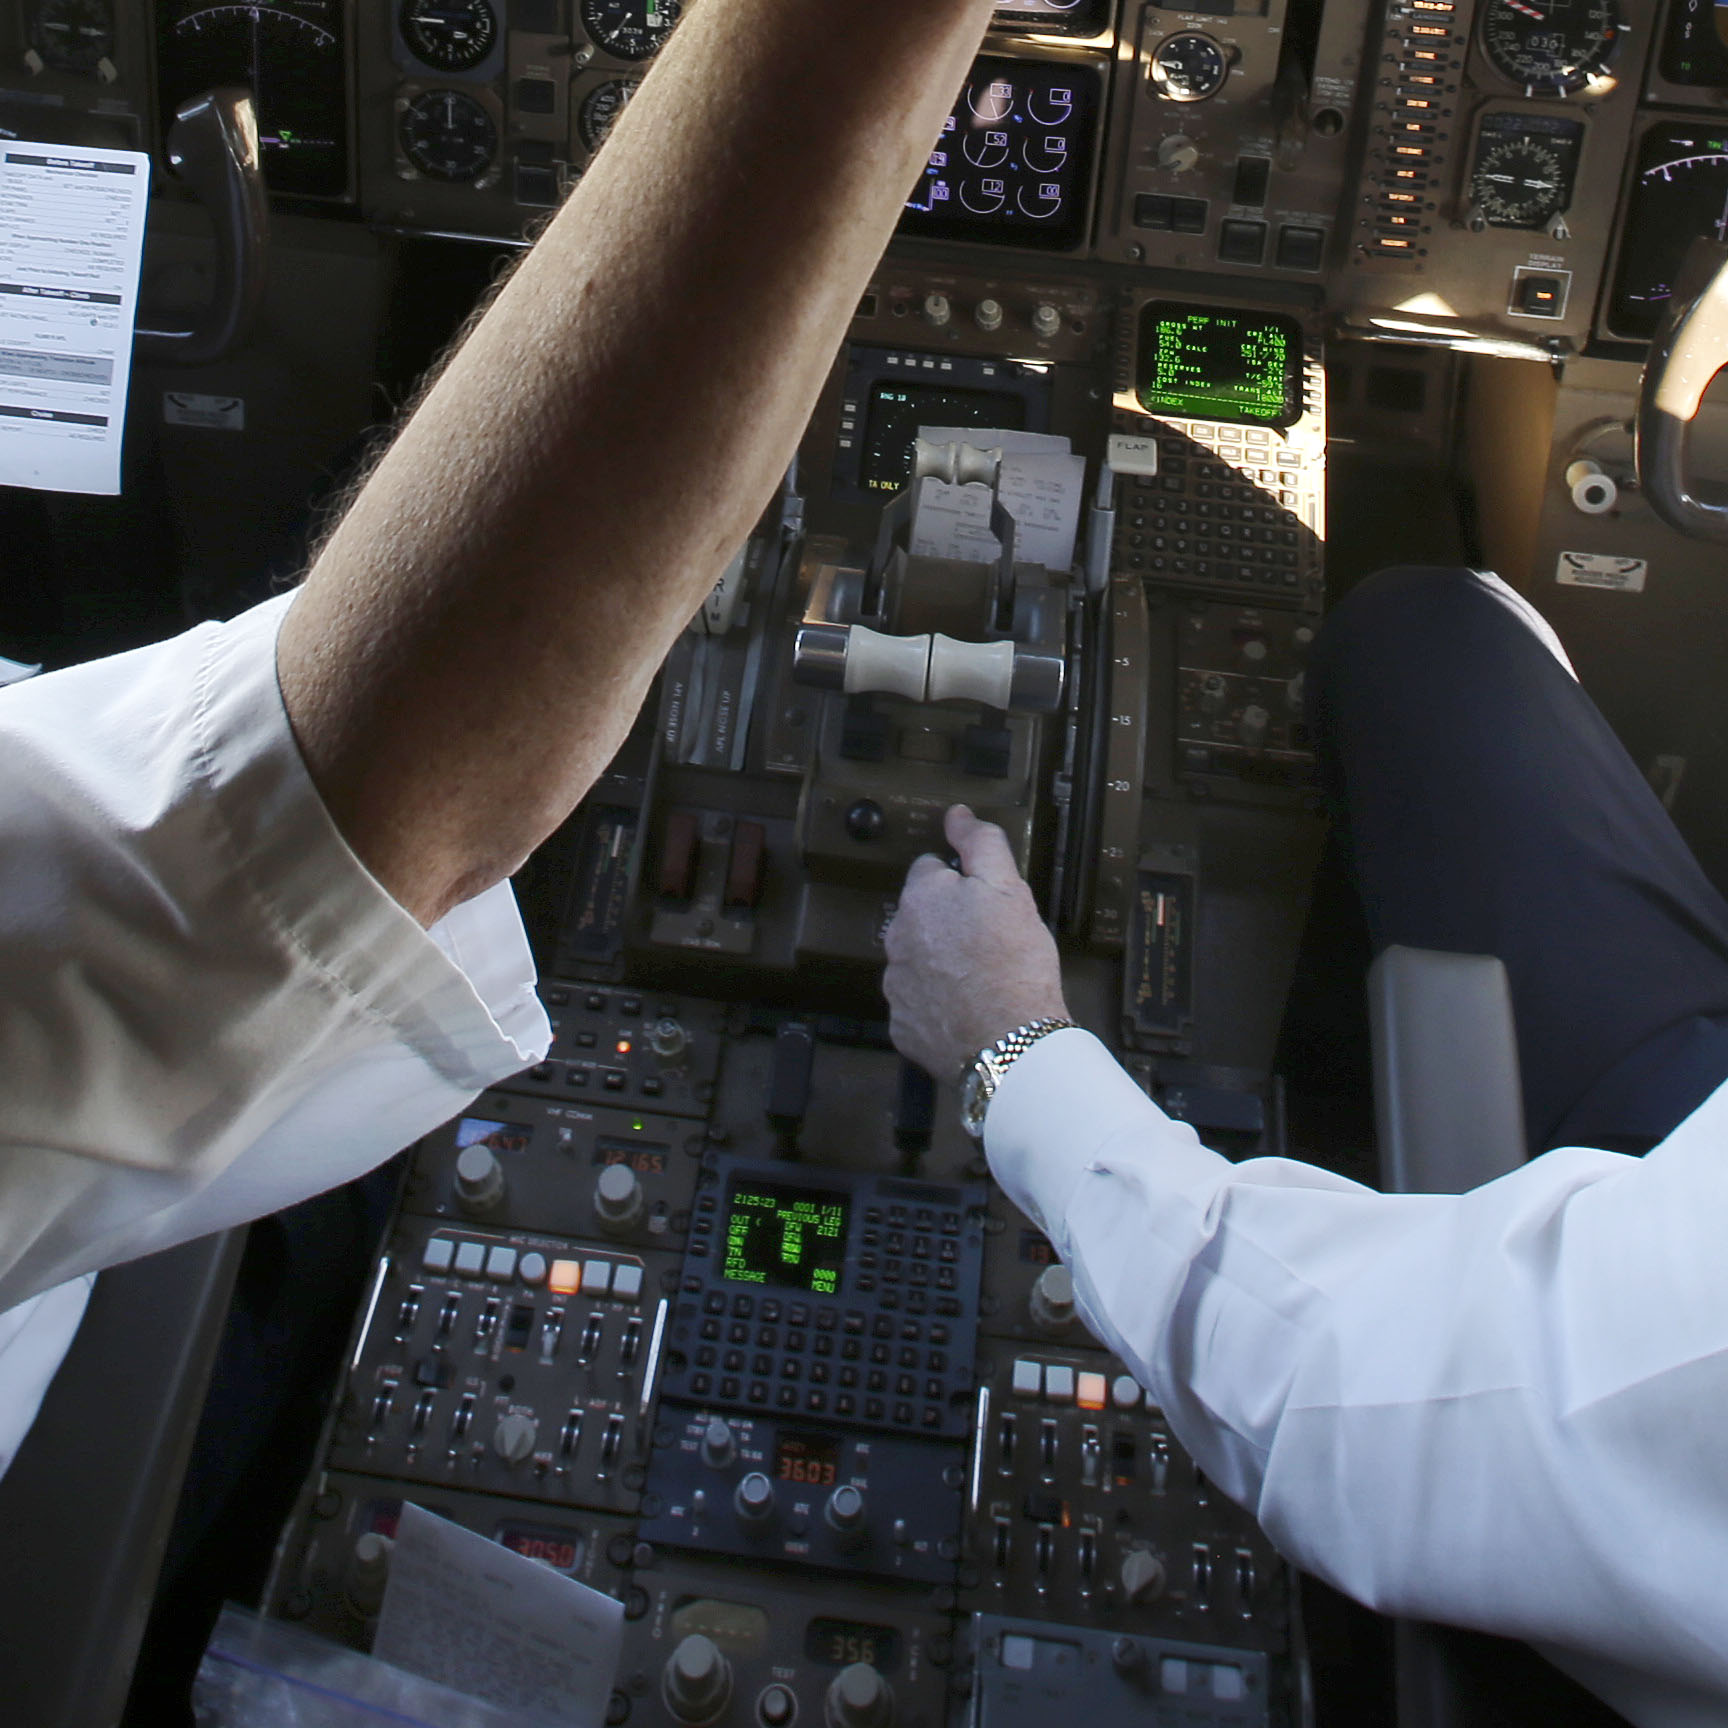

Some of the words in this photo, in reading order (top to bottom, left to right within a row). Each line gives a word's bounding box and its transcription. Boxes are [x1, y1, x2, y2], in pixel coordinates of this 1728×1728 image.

[1185, 380, 1211, 388] INDEX
[1117, 441, 1149, 451] FLAP
[881, 480, 899, 490] ONLY
[1122, 657, 1130, 667] 5
[1119, 715, 1131, 725] 15
[1115, 781, 1130, 791] 20
[731, 1214, 750, 1225] OUT
[777, 1209, 820, 1224] PREVIOUS
[729, 1224, 749, 1235] OFF
[724, 1269, 766, 1283] MESSAGE
[812, 1280, 835, 1293] MENU
[779, 1457, 835, 1486] 3603
[833, 1635, 874, 1662] 356
